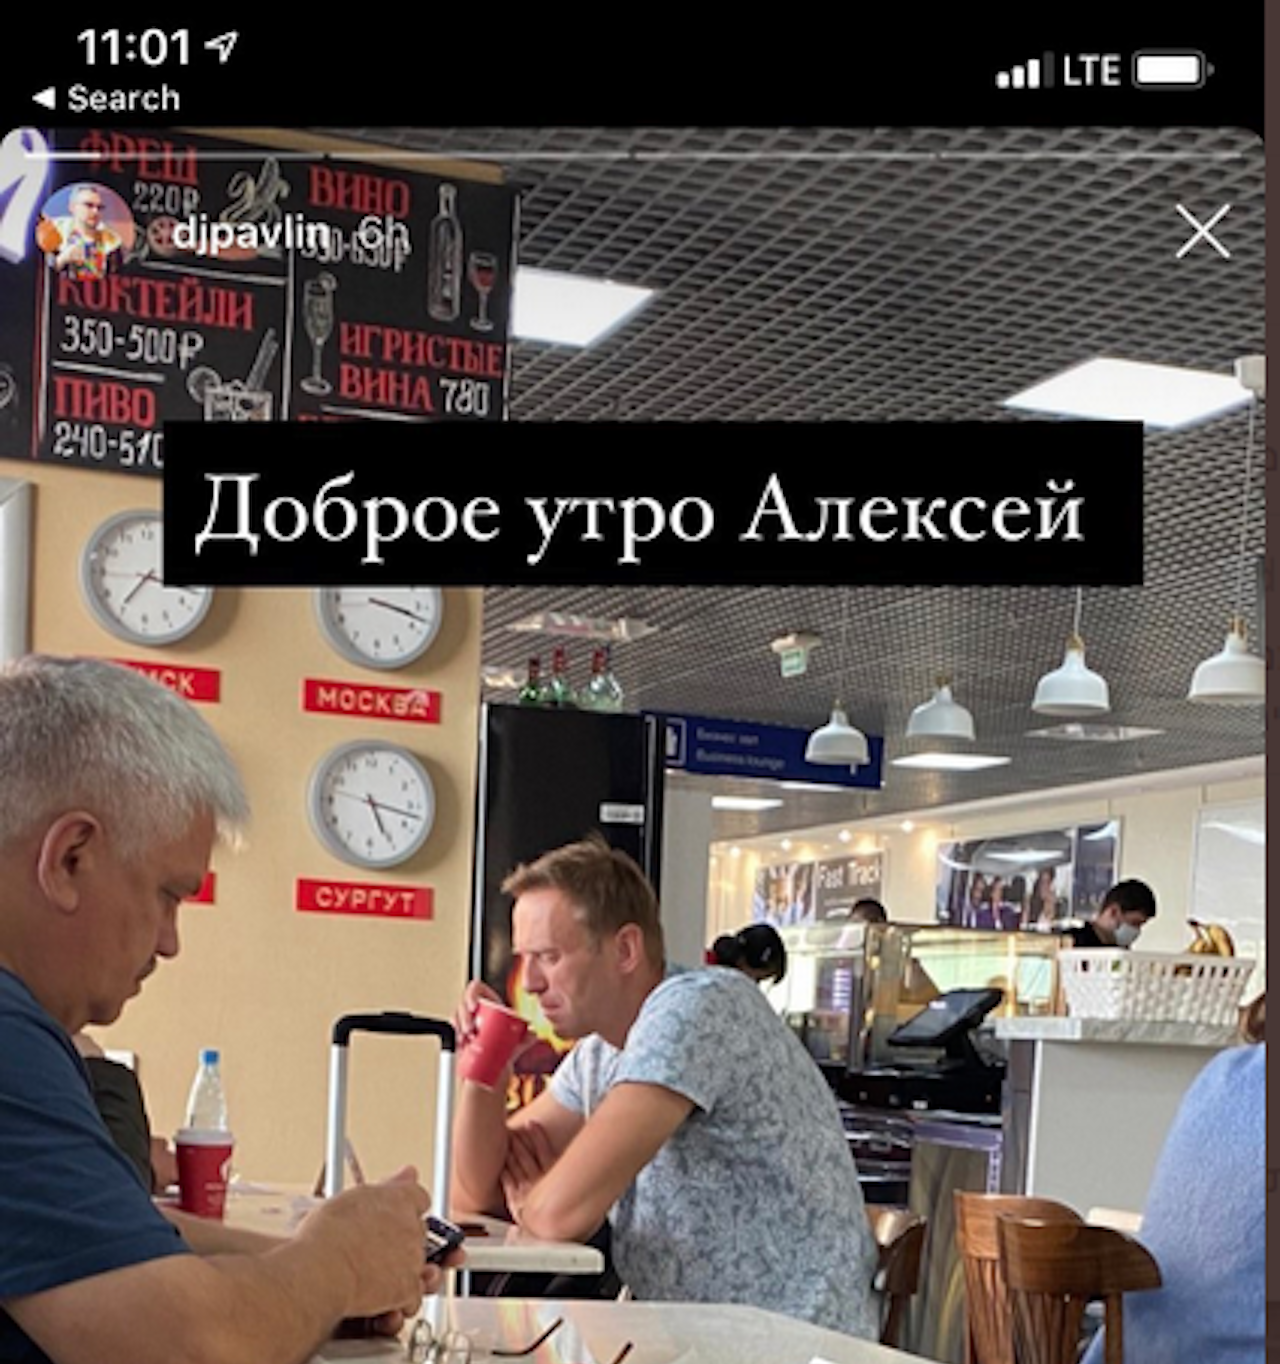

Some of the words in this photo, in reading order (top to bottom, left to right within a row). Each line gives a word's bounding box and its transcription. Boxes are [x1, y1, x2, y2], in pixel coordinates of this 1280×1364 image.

[79, 127, 198, 185] ФРЕШ
[309, 164, 411, 219] ВИНО
[57, 272, 255, 331] КОКТЕЙЛИ
[340, 321, 503, 379] ИГРИСТЫЕ
[53, 376, 157, 430] ПИВО
[339, 363, 434, 413] ВИНА
[440, 378, 491, 418] 780
[316, 686, 428, 718] МОСКВА
[315, 885, 417, 915] СУРГУТ
[818, 864, 844, 889] Fast
